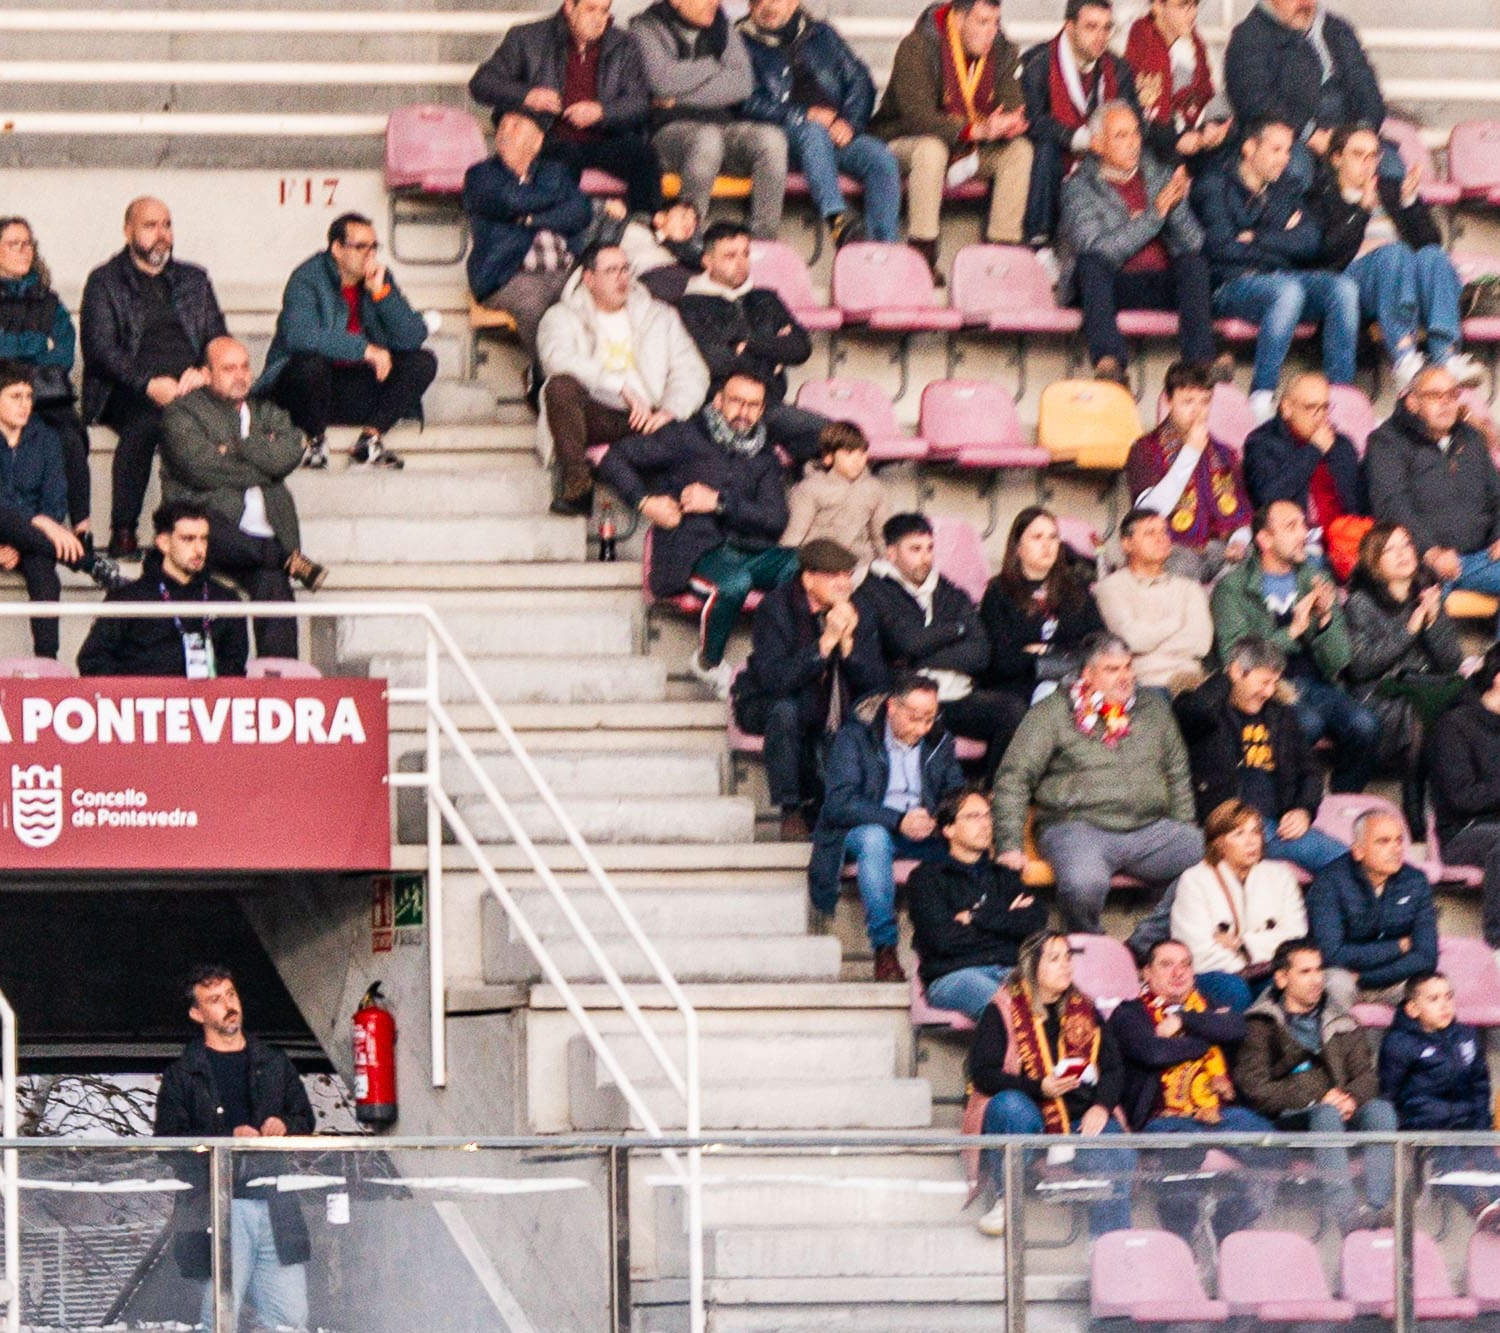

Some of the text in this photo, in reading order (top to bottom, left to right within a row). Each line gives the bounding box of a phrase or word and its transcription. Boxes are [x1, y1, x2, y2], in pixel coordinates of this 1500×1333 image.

[22, 697, 367, 744] PONTEVEDRA
[71, 787, 148, 807] Concello
[71, 807, 199, 828] de Pontevedra
